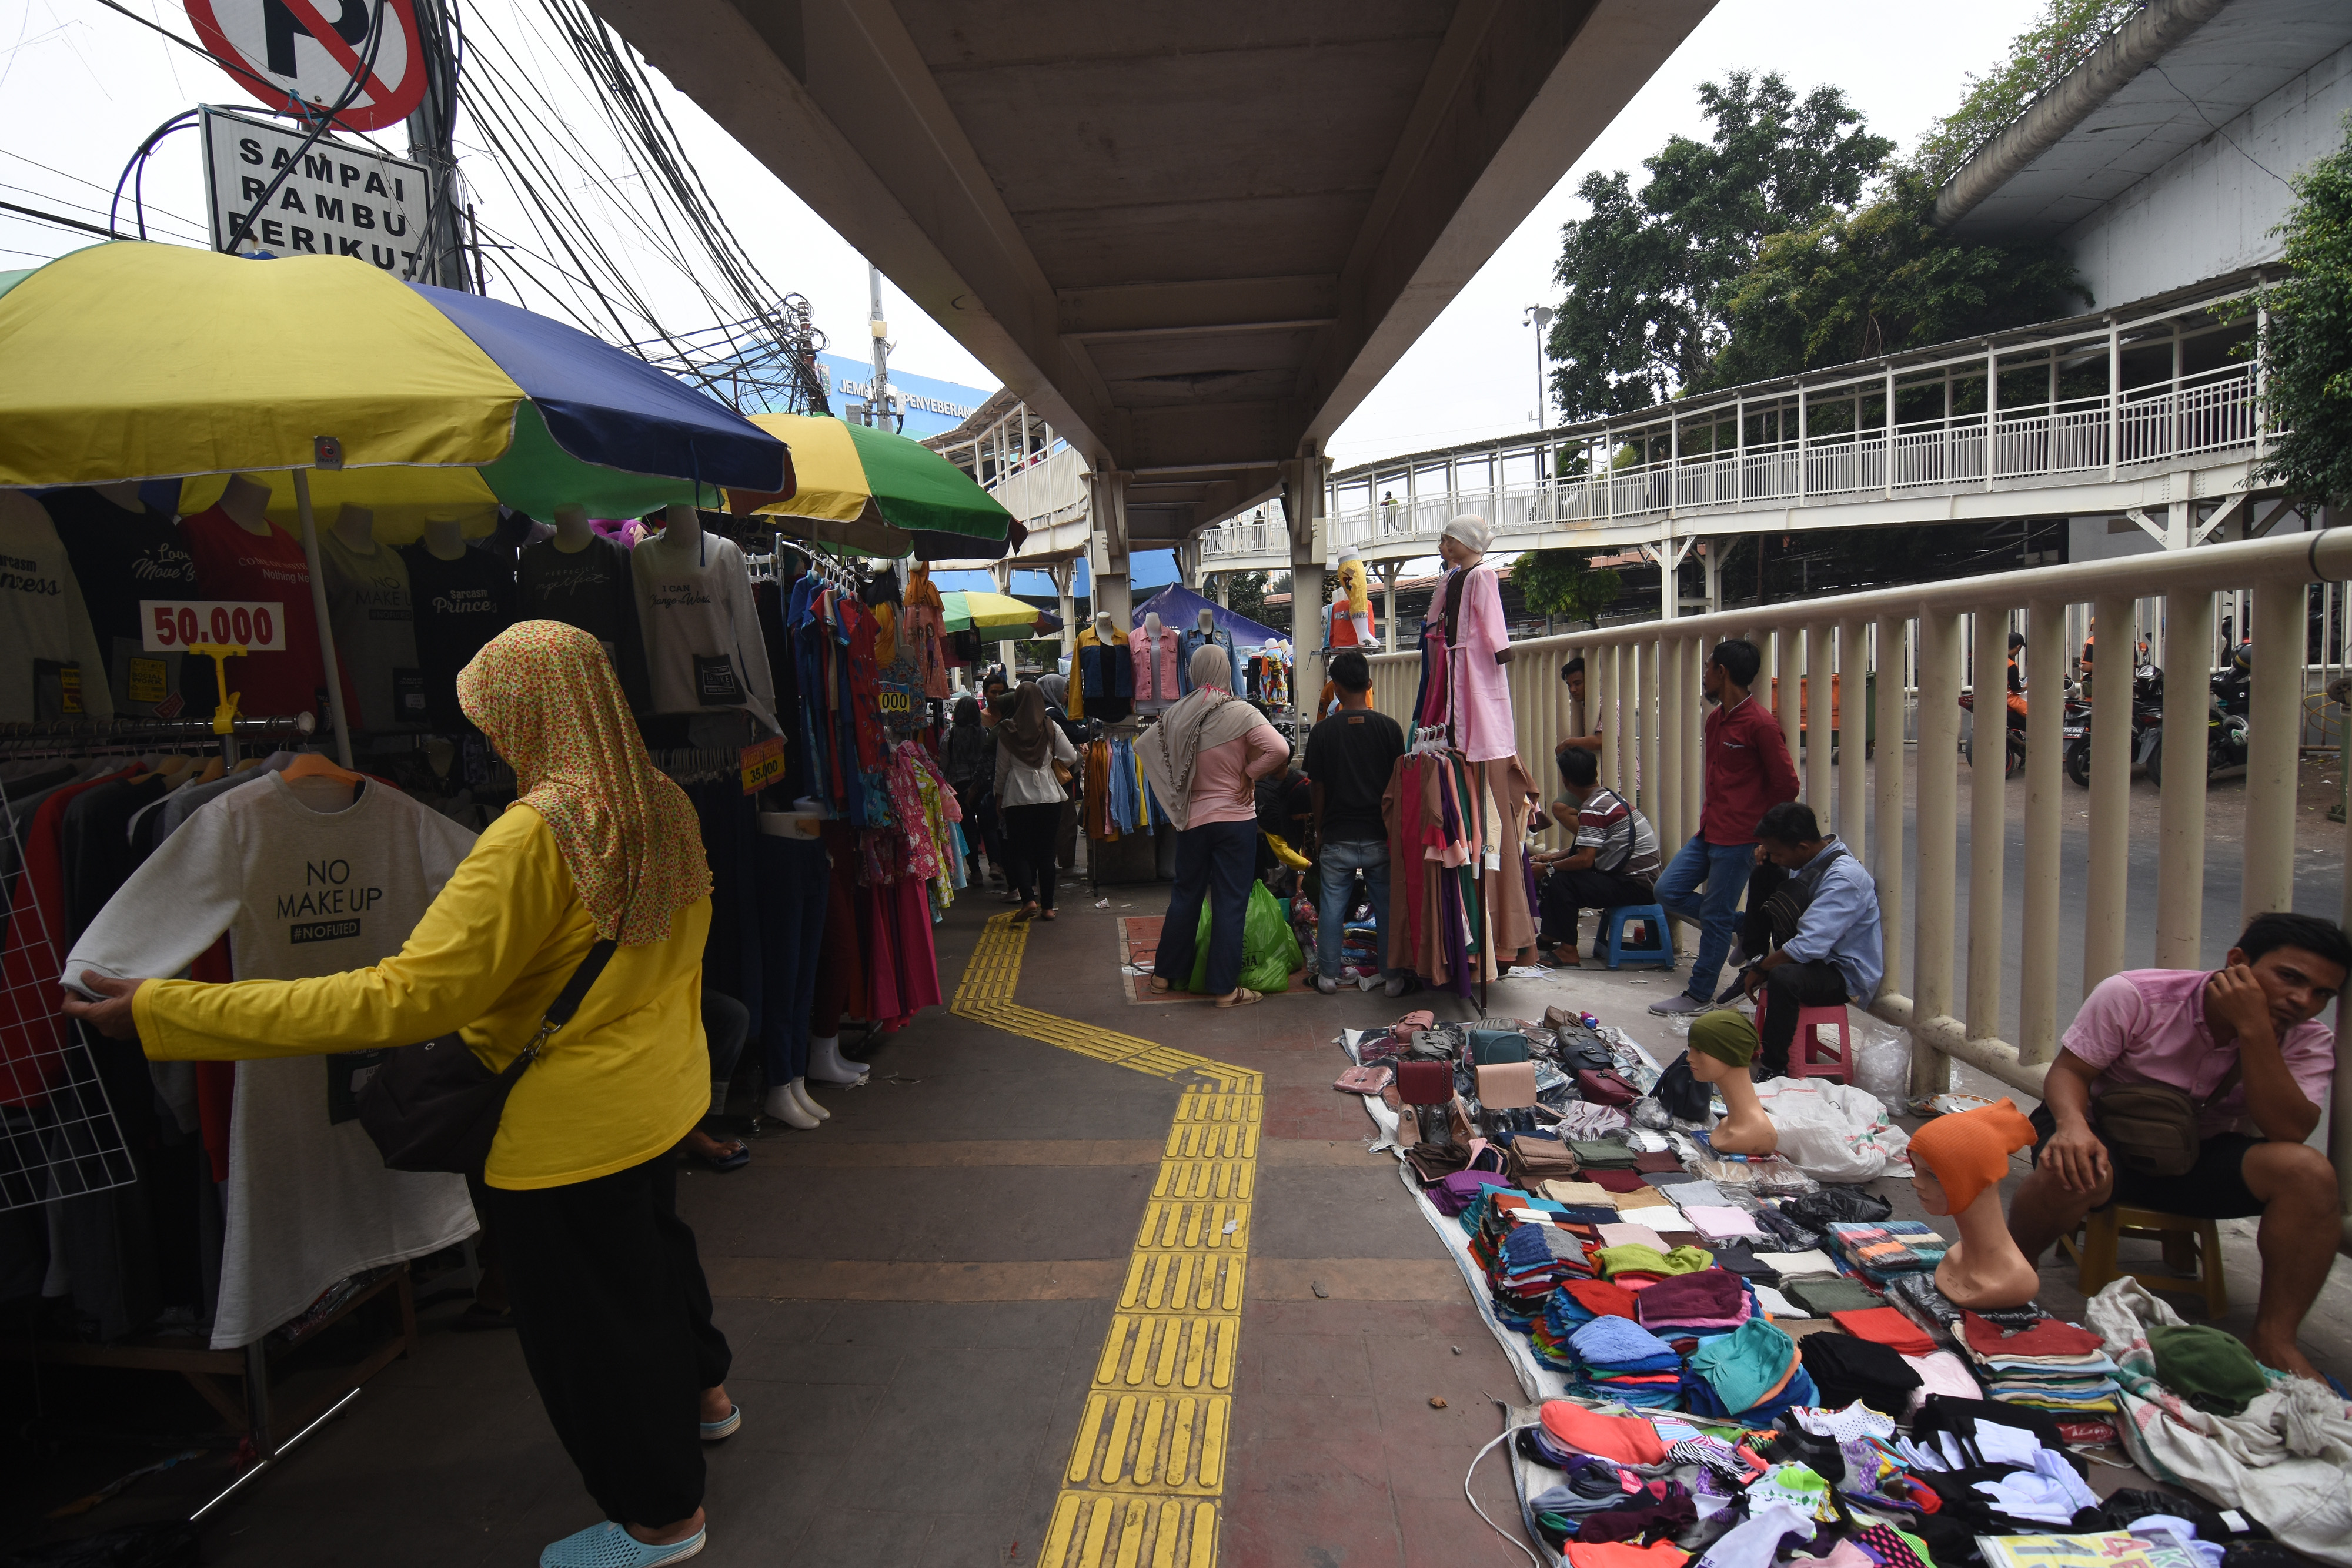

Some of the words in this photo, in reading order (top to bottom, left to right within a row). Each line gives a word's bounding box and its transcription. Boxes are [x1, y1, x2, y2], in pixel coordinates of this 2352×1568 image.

[240, 138, 404, 203] SAMPAI
[242, 175, 406, 237] RAMBU
[0, 554, 37, 573] arcasm
[132, 558, 181, 580] Move
[262, 568, 296, 584] Nothing
[297, 573, 310, 583] Ne
[369, 576, 400, 589] NO
[356, 590, 400, 606] MAKE
[450, 589, 488, 599] Sarcasm
[154, 607, 273, 646] 50.000
[750, 760, 778, 783] 35.000
[307, 859, 350, 886] NO
[277, 889, 345, 919] MAKE
[350, 887, 383, 912] UP
[294, 922, 358, 940] #NOFUTED
